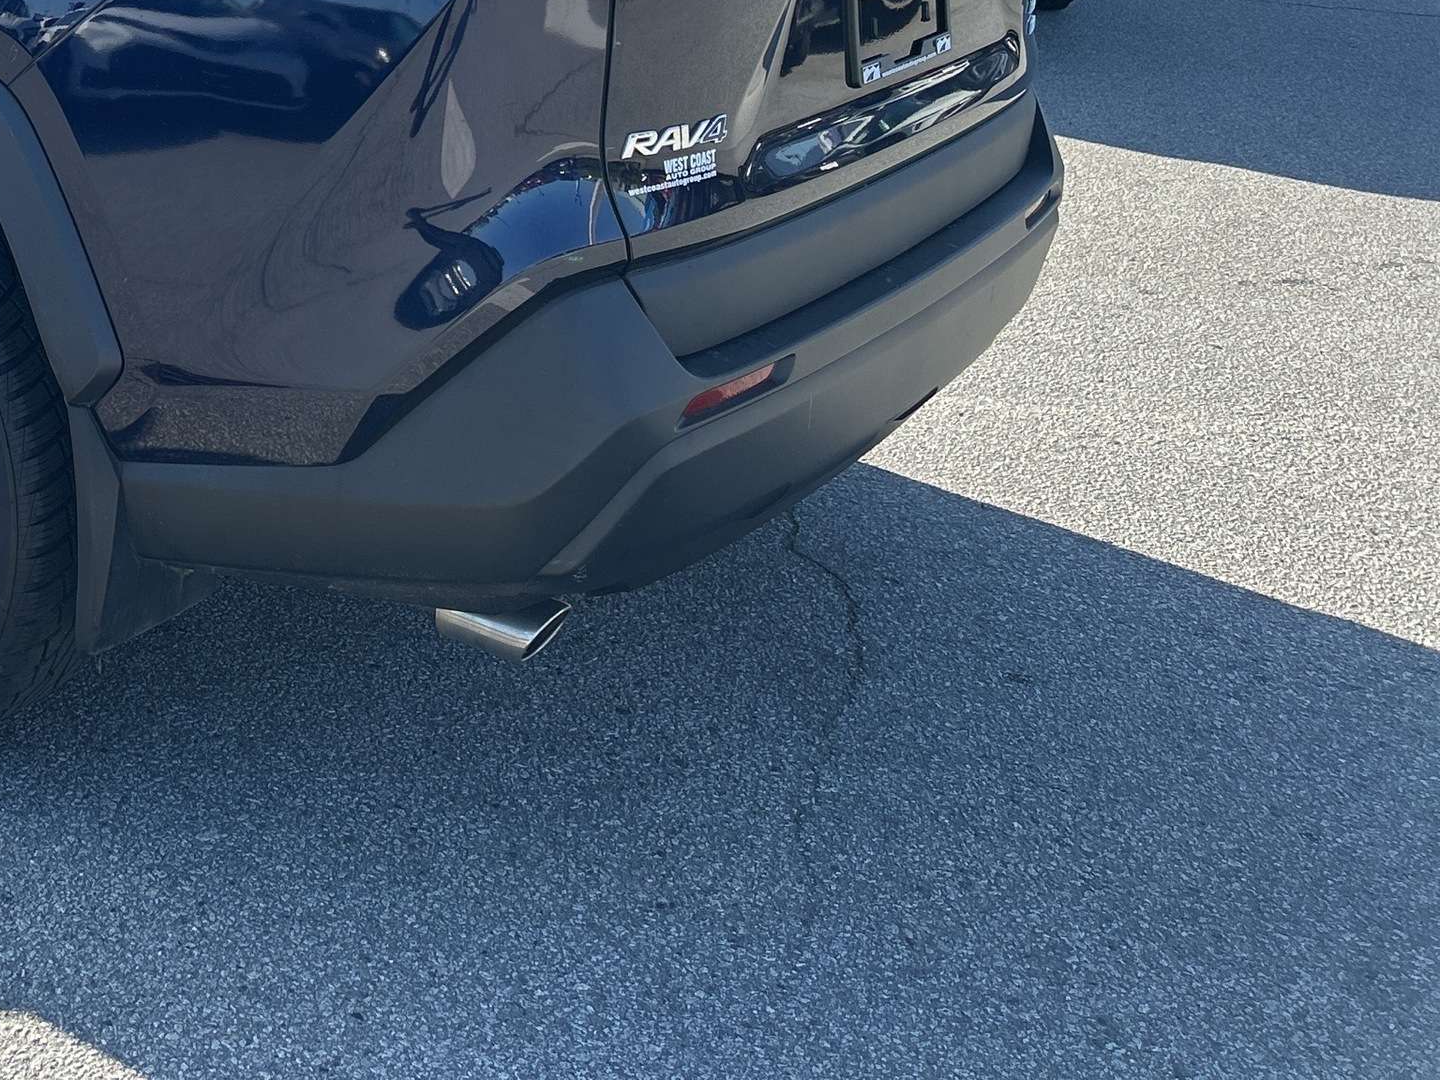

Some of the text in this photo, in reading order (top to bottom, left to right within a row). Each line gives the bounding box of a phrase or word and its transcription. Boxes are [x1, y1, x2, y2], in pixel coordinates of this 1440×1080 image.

[621, 114, 728, 160] RAV4
[663, 149, 717, 175] WEST COAST
[666, 163, 716, 181] AUTO GROUP
[628, 170, 717, 197] westcoastautogroup.com
